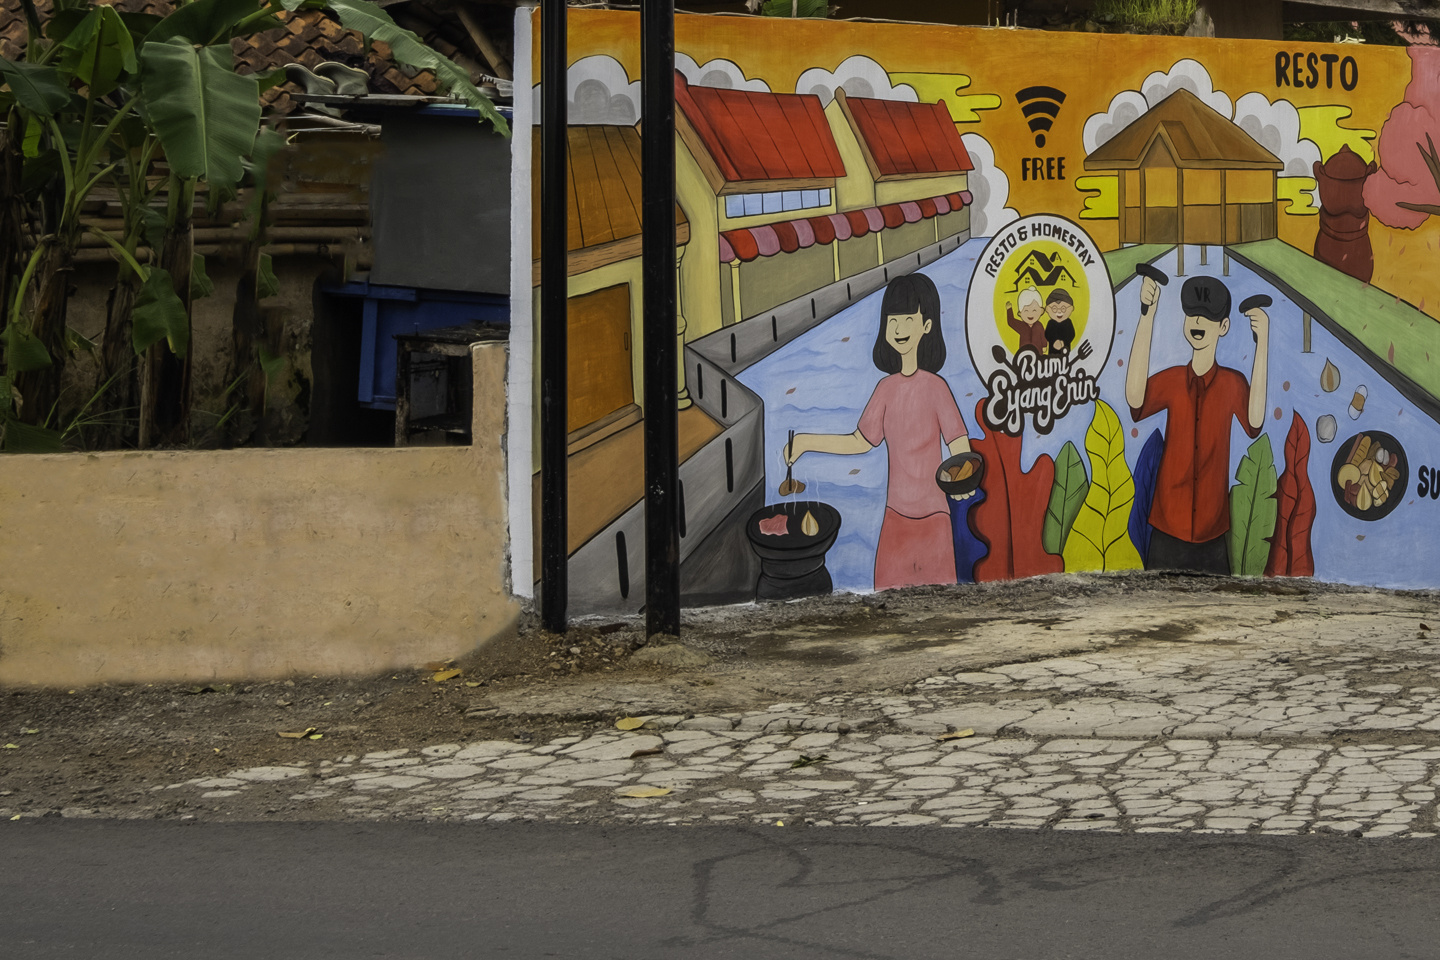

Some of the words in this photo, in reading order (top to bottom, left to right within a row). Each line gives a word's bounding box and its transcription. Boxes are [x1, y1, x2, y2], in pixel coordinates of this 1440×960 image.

[1275, 51, 1358, 91] RESTO
[1021, 156, 1066, 181] FREE
[984, 231, 1018, 278] RESTO
[1019, 225, 1029, 242] &
[1031, 223, 1096, 268] HOMESTAY
[1194, 286, 1211, 303] VR
[1016, 348, 1070, 382] Bumi
[986, 373, 1051, 435] Eyang
[1052, 371, 1097, 416] Enin
